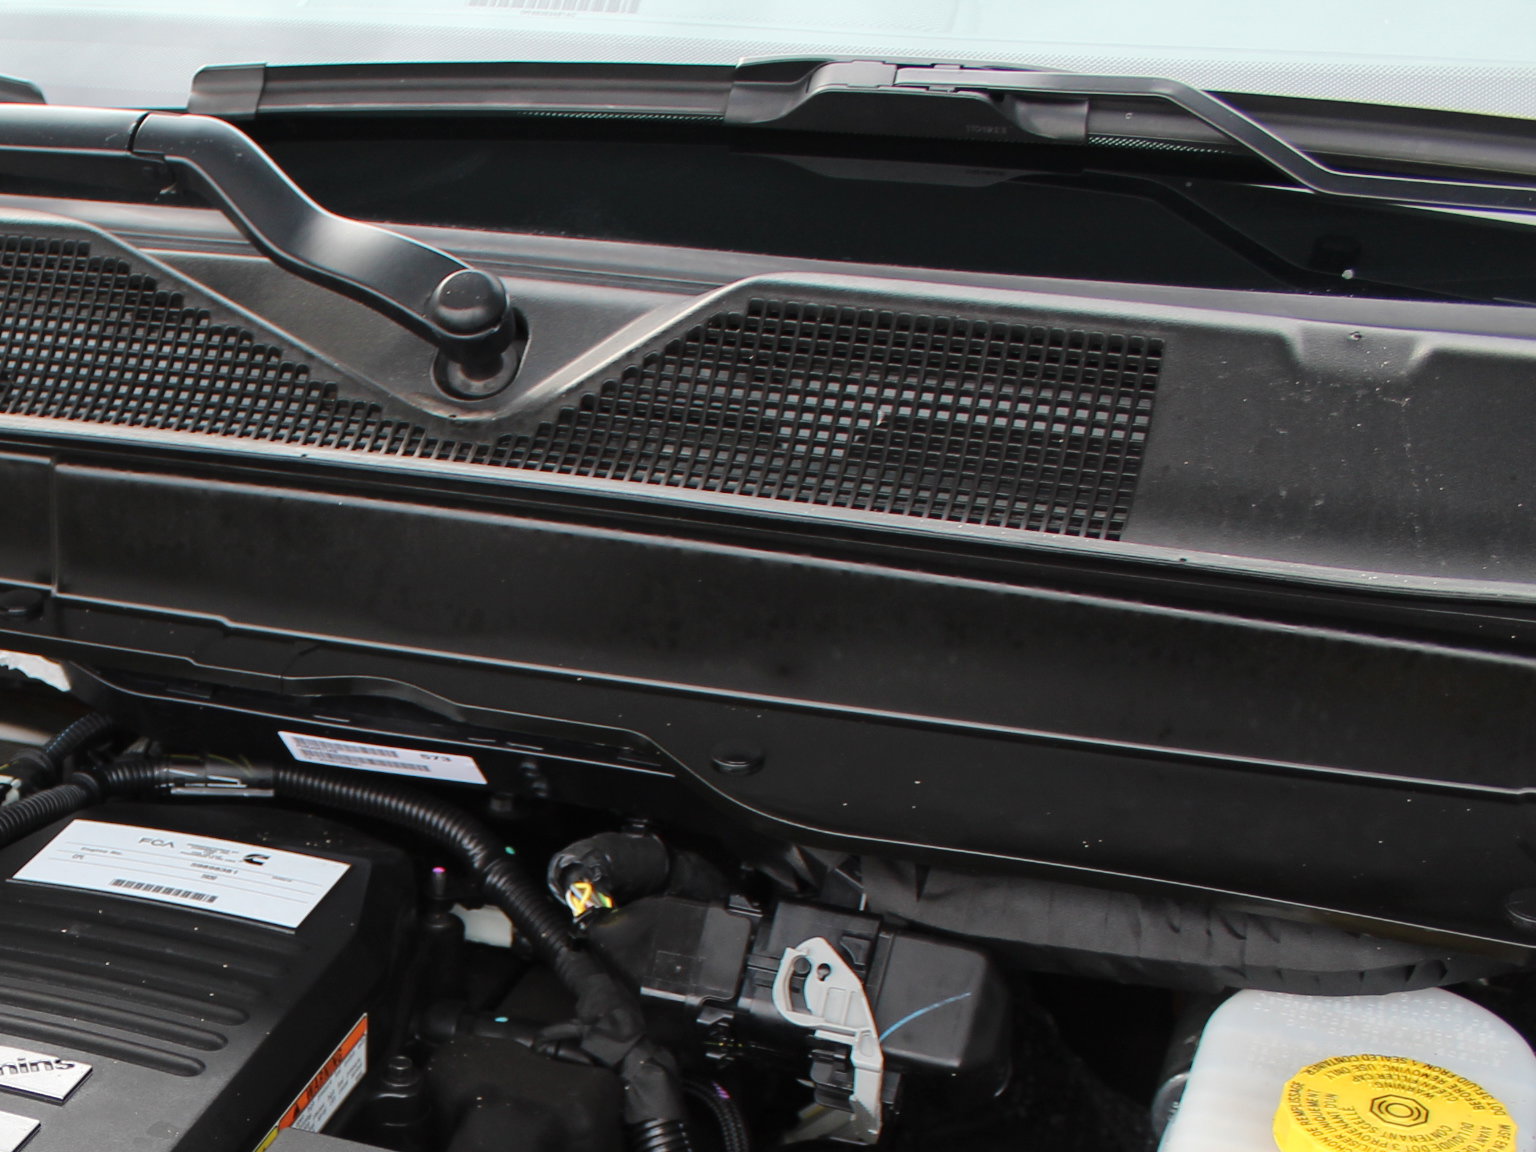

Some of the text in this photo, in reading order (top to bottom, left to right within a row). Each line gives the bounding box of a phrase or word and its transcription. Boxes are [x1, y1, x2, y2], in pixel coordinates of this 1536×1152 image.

[138, 837, 175, 848] FCA
[1301, 1055, 1360, 1075] CONTAINER
[1362, 1054, 1408, 1064] SEALED
[1324, 1066, 1351, 1080] ONLY
[1423, 1063, 1457, 1078] FROM
[1353, 1073, 1459, 1102] CLEAN FILLER CAP
[1456, 1077, 1484, 1096] FLUID
[1288, 1081, 1312, 1126] REMPLISSAGE
[1448, 1084, 1485, 1110] BEFORE
[1305, 1089, 1338, 1133] UNIQUEMENT
[1486, 1100, 1506, 1116] DOT
[1307, 1127, 1324, 1137] DE
[1327, 1112, 1387, 1148] PROVENANT
[1380, 1125, 1452, 1143] CONTENANT
[1460, 1122, 1474, 1133] DU
[1497, 1124, 1511, 1140] MISE
[1432, 1132, 1472, 1150] LIQUIDE
[1473, 1126, 1492, 1147] AVANT
[1492, 1139, 1508, 1150] EN
[1406, 1144, 1431, 1152] DOT
